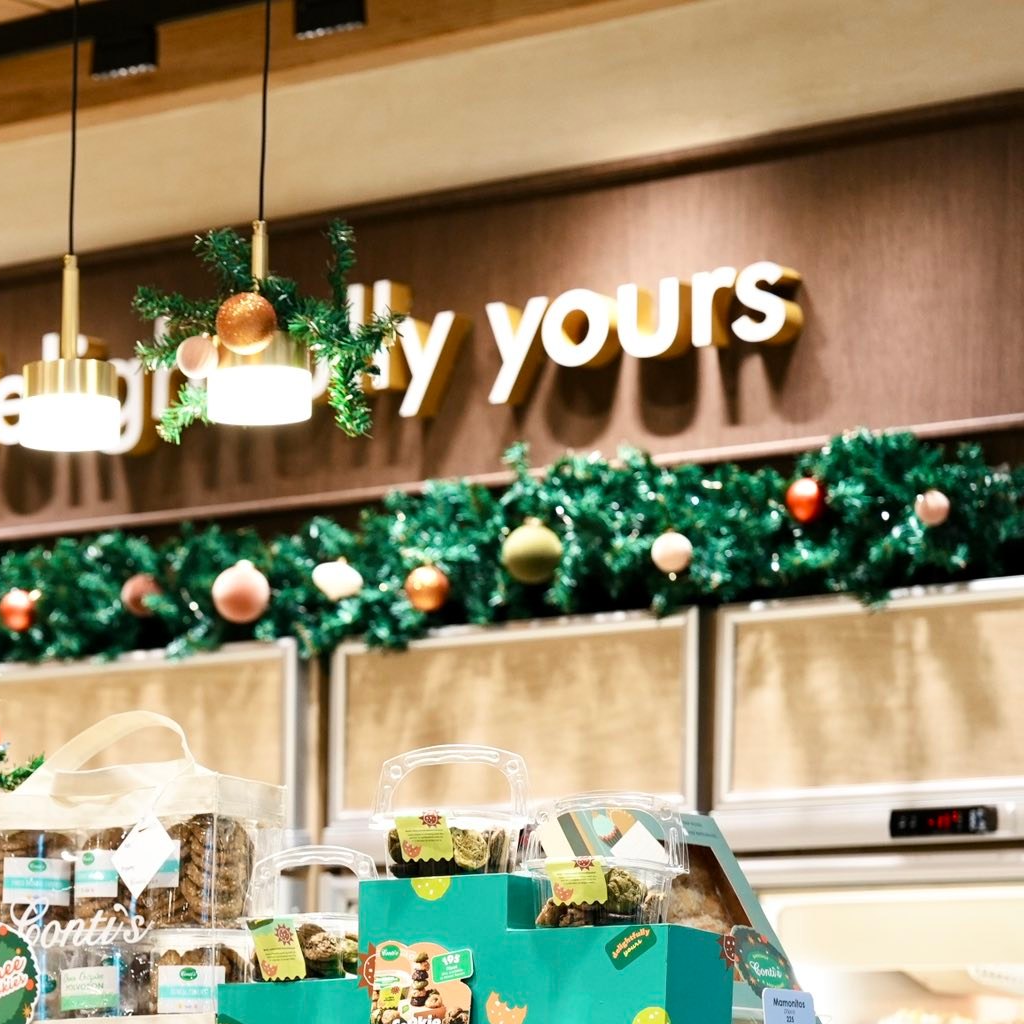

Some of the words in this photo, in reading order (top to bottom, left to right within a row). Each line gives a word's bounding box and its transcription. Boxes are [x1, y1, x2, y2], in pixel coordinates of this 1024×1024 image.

[485, 260, 796, 405] yours
[9, 897, 156, 949] Conti's
[773, 997, 806, 1009] Mamonitos
